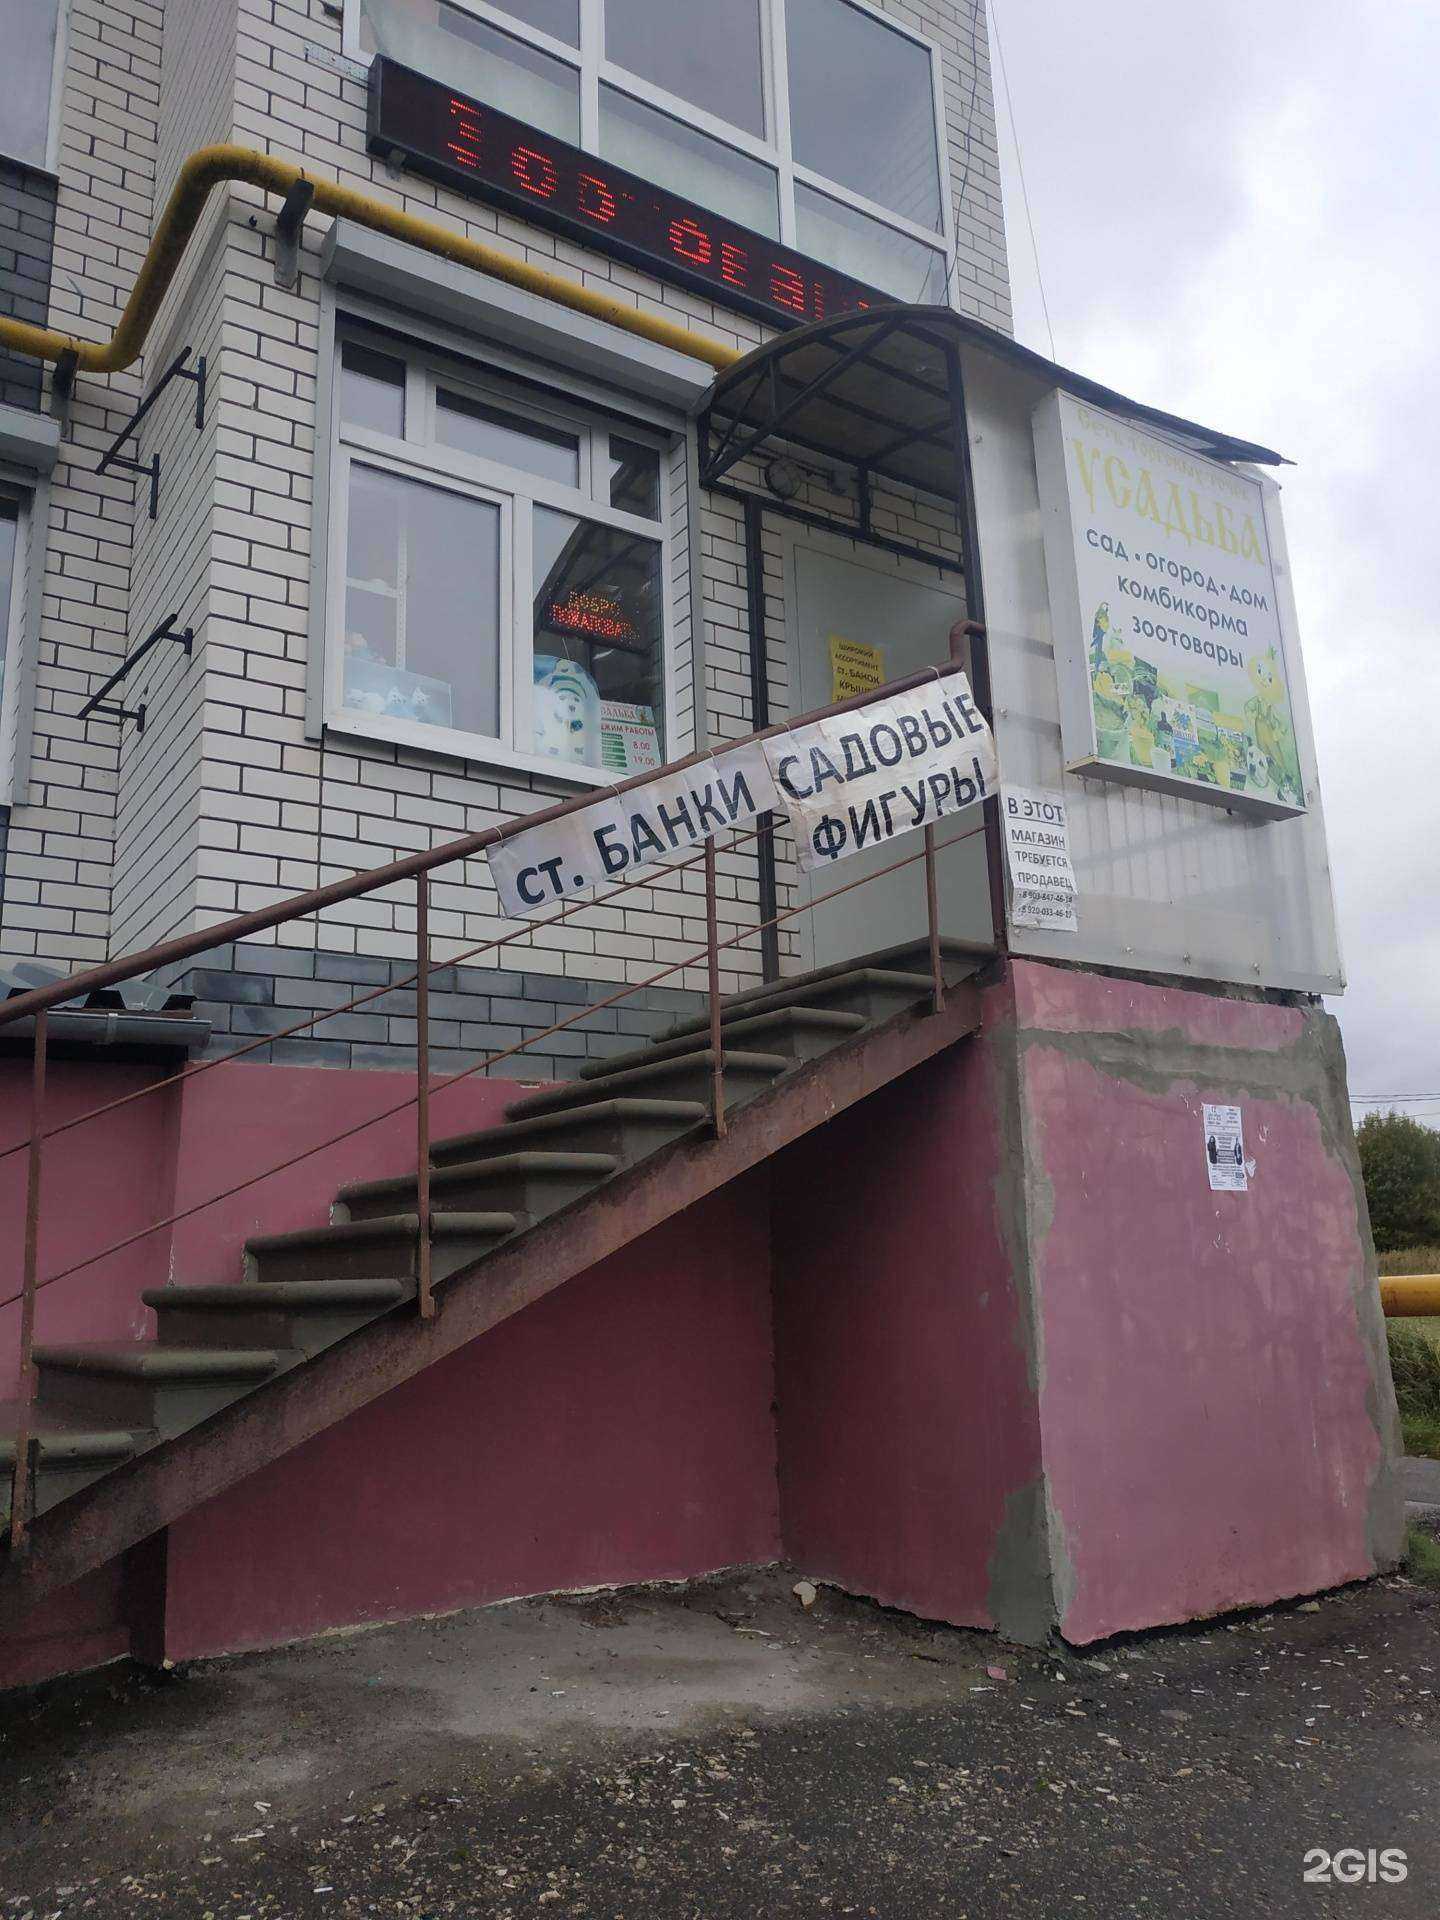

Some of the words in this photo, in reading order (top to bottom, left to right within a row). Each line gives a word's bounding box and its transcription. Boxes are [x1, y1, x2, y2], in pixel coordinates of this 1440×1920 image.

[1071, 438, 1265, 566] УСАДЬБА
[1086, 526, 1129, 563] сад
[1145, 550, 1220, 593] огород
[1229, 582, 1269, 612] дом
[1117, 575, 1249, 638] комбикорма
[1132, 615, 1245, 669] зоотовары
[593, 770, 757, 876] БАНКИ
[778, 692, 984, 800] САДОВЫЕ
[812, 757, 987, 860] ФИГУРЫ
[1007, 797, 1019, 814] В
[1023, 799, 1063, 822] ЭТОТ
[1011, 829, 1066, 848] МАГАЗИН
[1015, 850, 1068, 868] ТРЕБУЕТСЯ
[1017, 872, 1074, 891] ПРОДАВЕЦ
